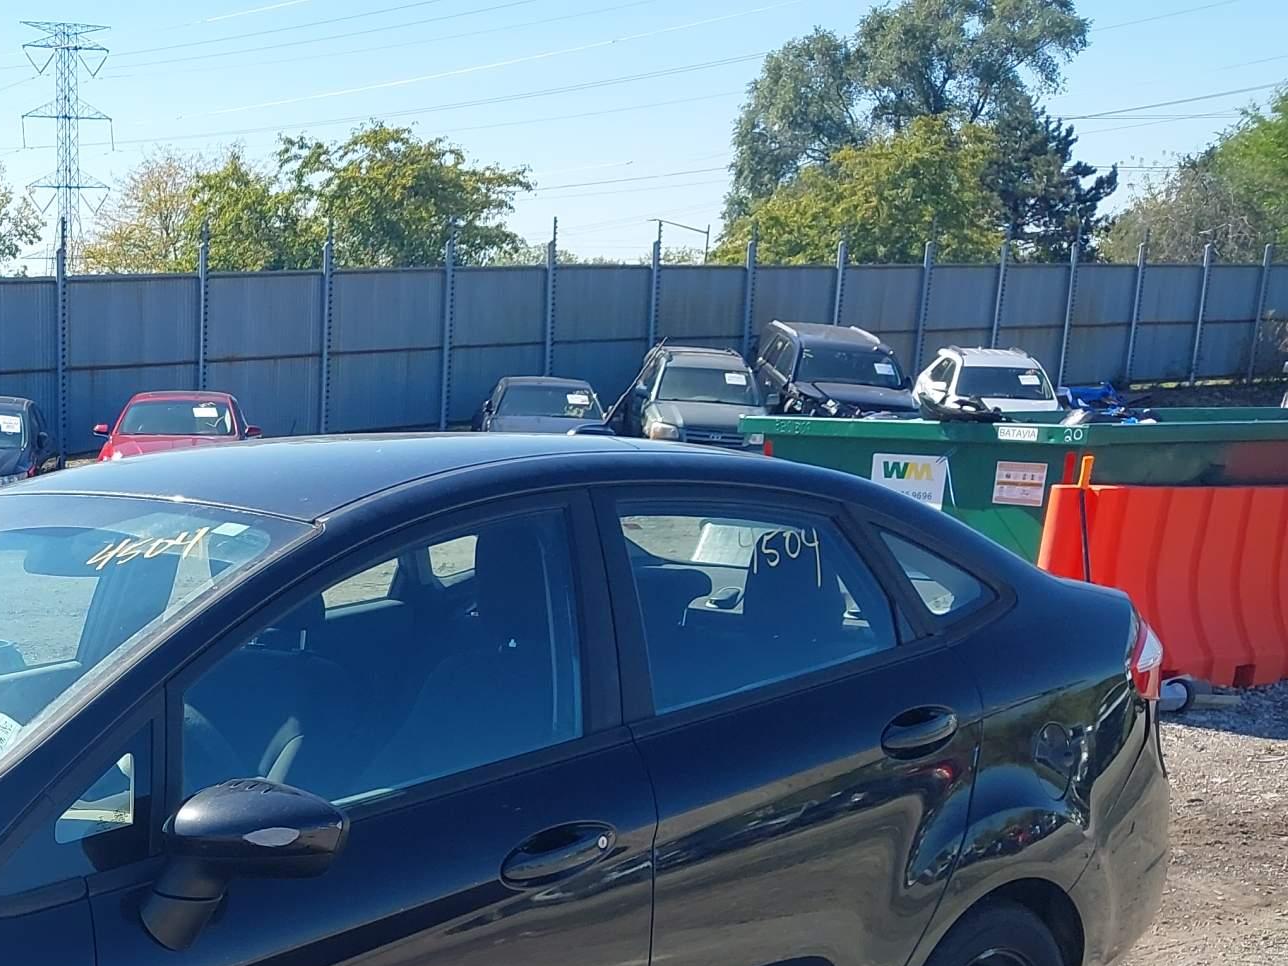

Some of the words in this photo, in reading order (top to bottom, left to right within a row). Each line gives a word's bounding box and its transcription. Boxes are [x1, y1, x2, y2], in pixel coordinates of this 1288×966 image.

[999, 427, 1037, 439] BATAVIA
[1064, 427, 1083, 442] 20
[883, 461, 933, 481] WM
[86, 526, 211, 571] 4504
